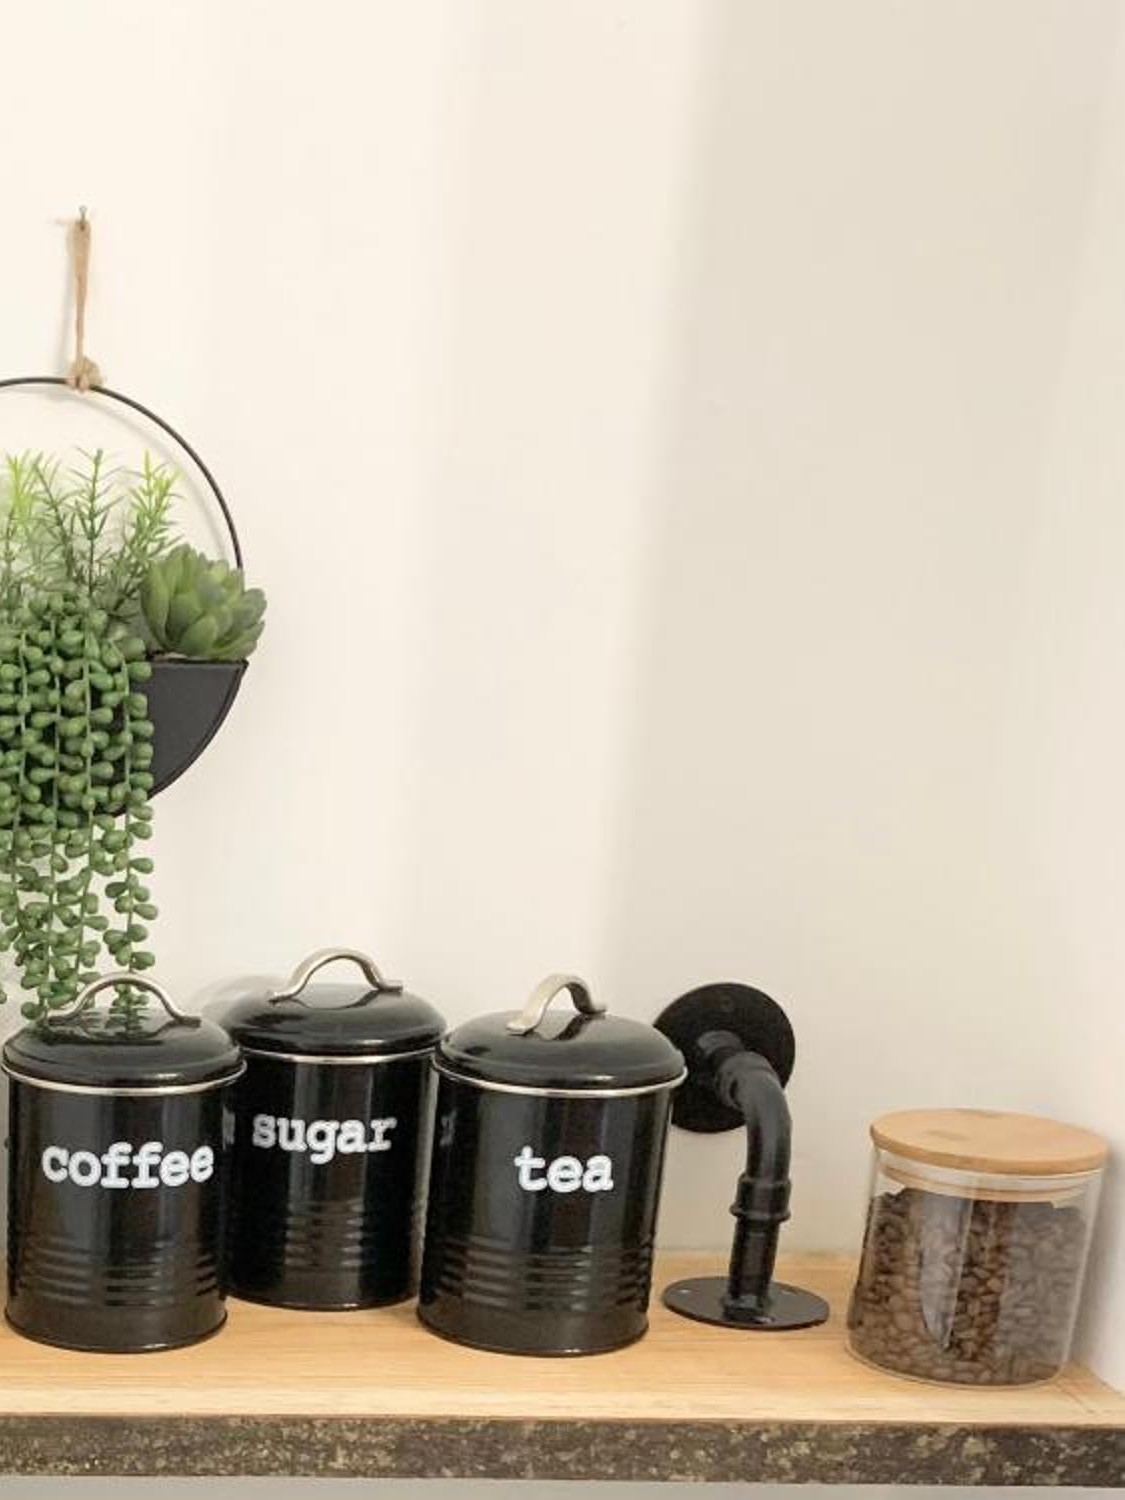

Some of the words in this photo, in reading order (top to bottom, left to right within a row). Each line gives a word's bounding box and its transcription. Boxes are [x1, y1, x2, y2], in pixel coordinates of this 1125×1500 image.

[252, 1113, 398, 1165] sugar
[42, 1141, 214, 1188] coffee
[514, 1145, 614, 1193] tea
